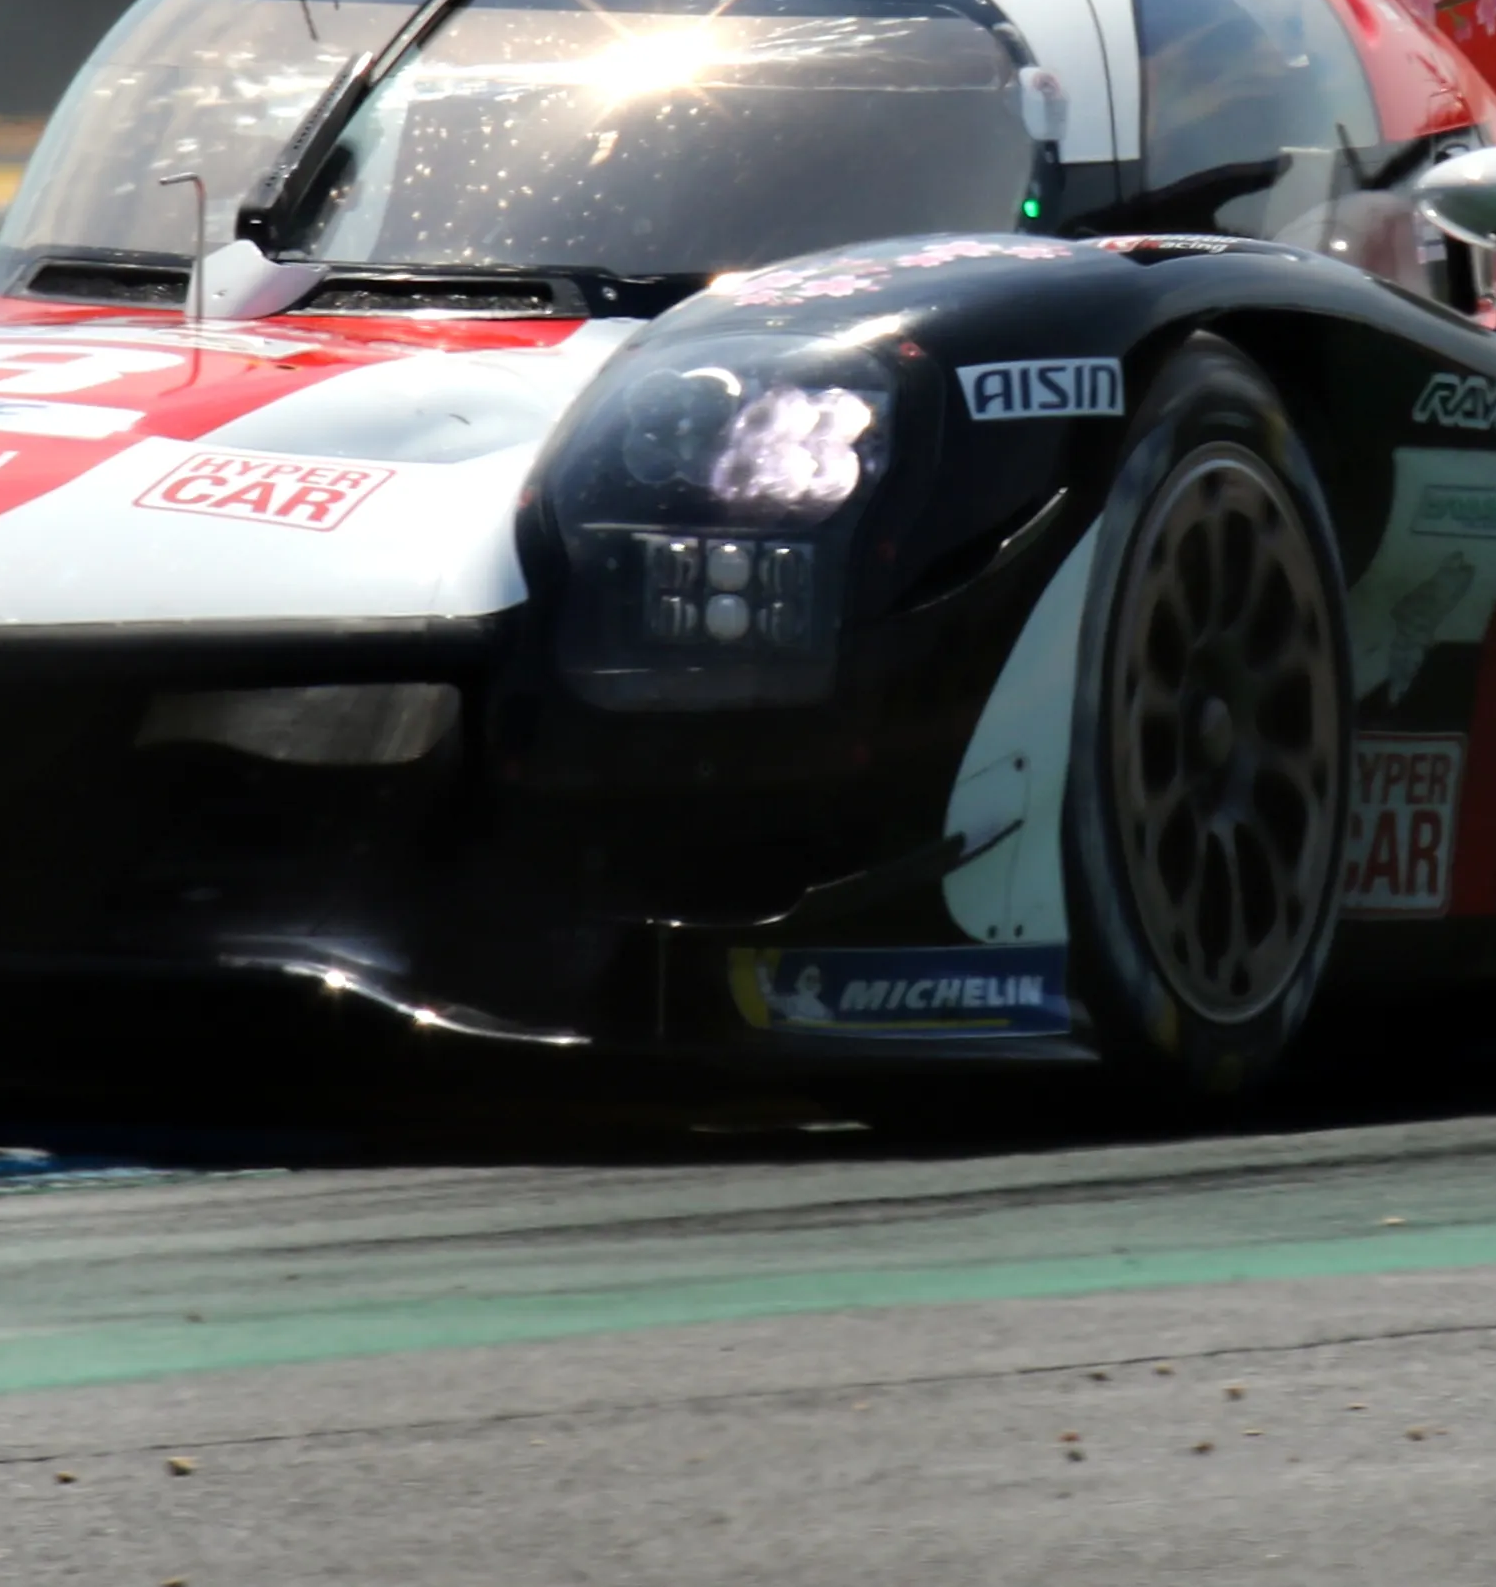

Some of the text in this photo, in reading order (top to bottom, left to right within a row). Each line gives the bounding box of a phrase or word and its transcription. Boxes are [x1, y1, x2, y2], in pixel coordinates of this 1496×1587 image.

[974, 363, 1119, 414] AISIN
[188, 456, 372, 490] HYPER
[160, 474, 347, 523] CAR
[839, 975, 1044, 1012] MICHELIN
